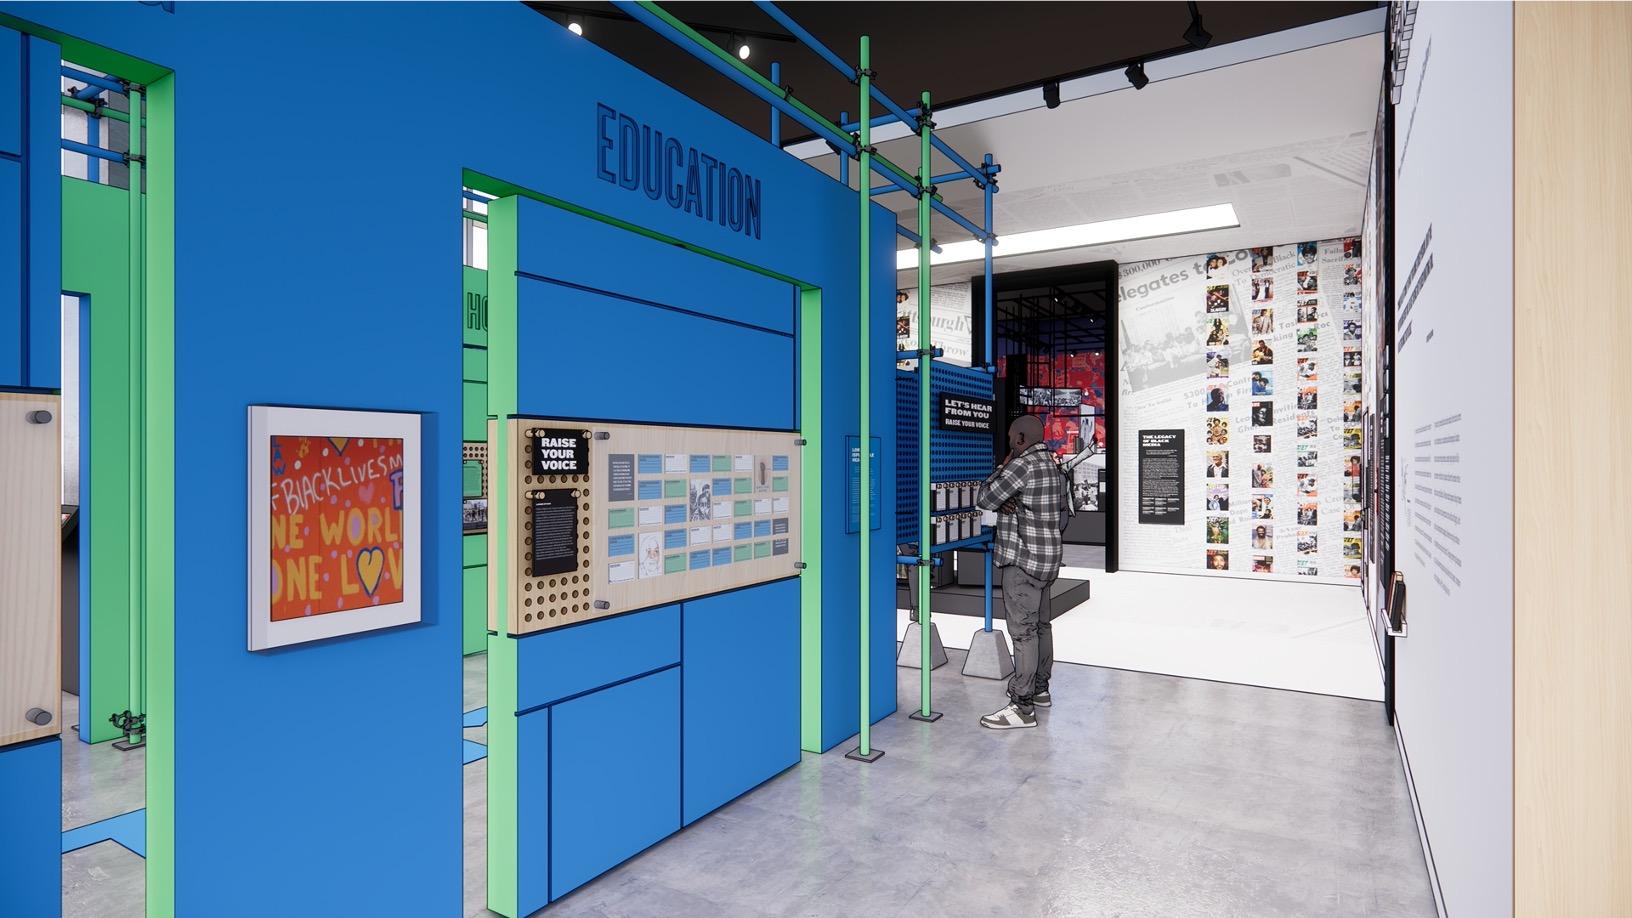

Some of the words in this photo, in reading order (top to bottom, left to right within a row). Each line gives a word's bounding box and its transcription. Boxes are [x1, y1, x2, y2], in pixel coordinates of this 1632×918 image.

[597, 102, 761, 240] EDUCATION
[945, 399, 970, 409] LET'S
[971, 403, 992, 412] HEAR
[945, 407, 971, 417] FROM
[973, 411, 989, 419] YOU
[945, 418, 960, 426] RAISE
[541, 438, 577, 447] RAISE
[541, 449, 575, 459] YOUR
[541, 460, 577, 470] VOICE
[319, 506, 403, 547] WORL
